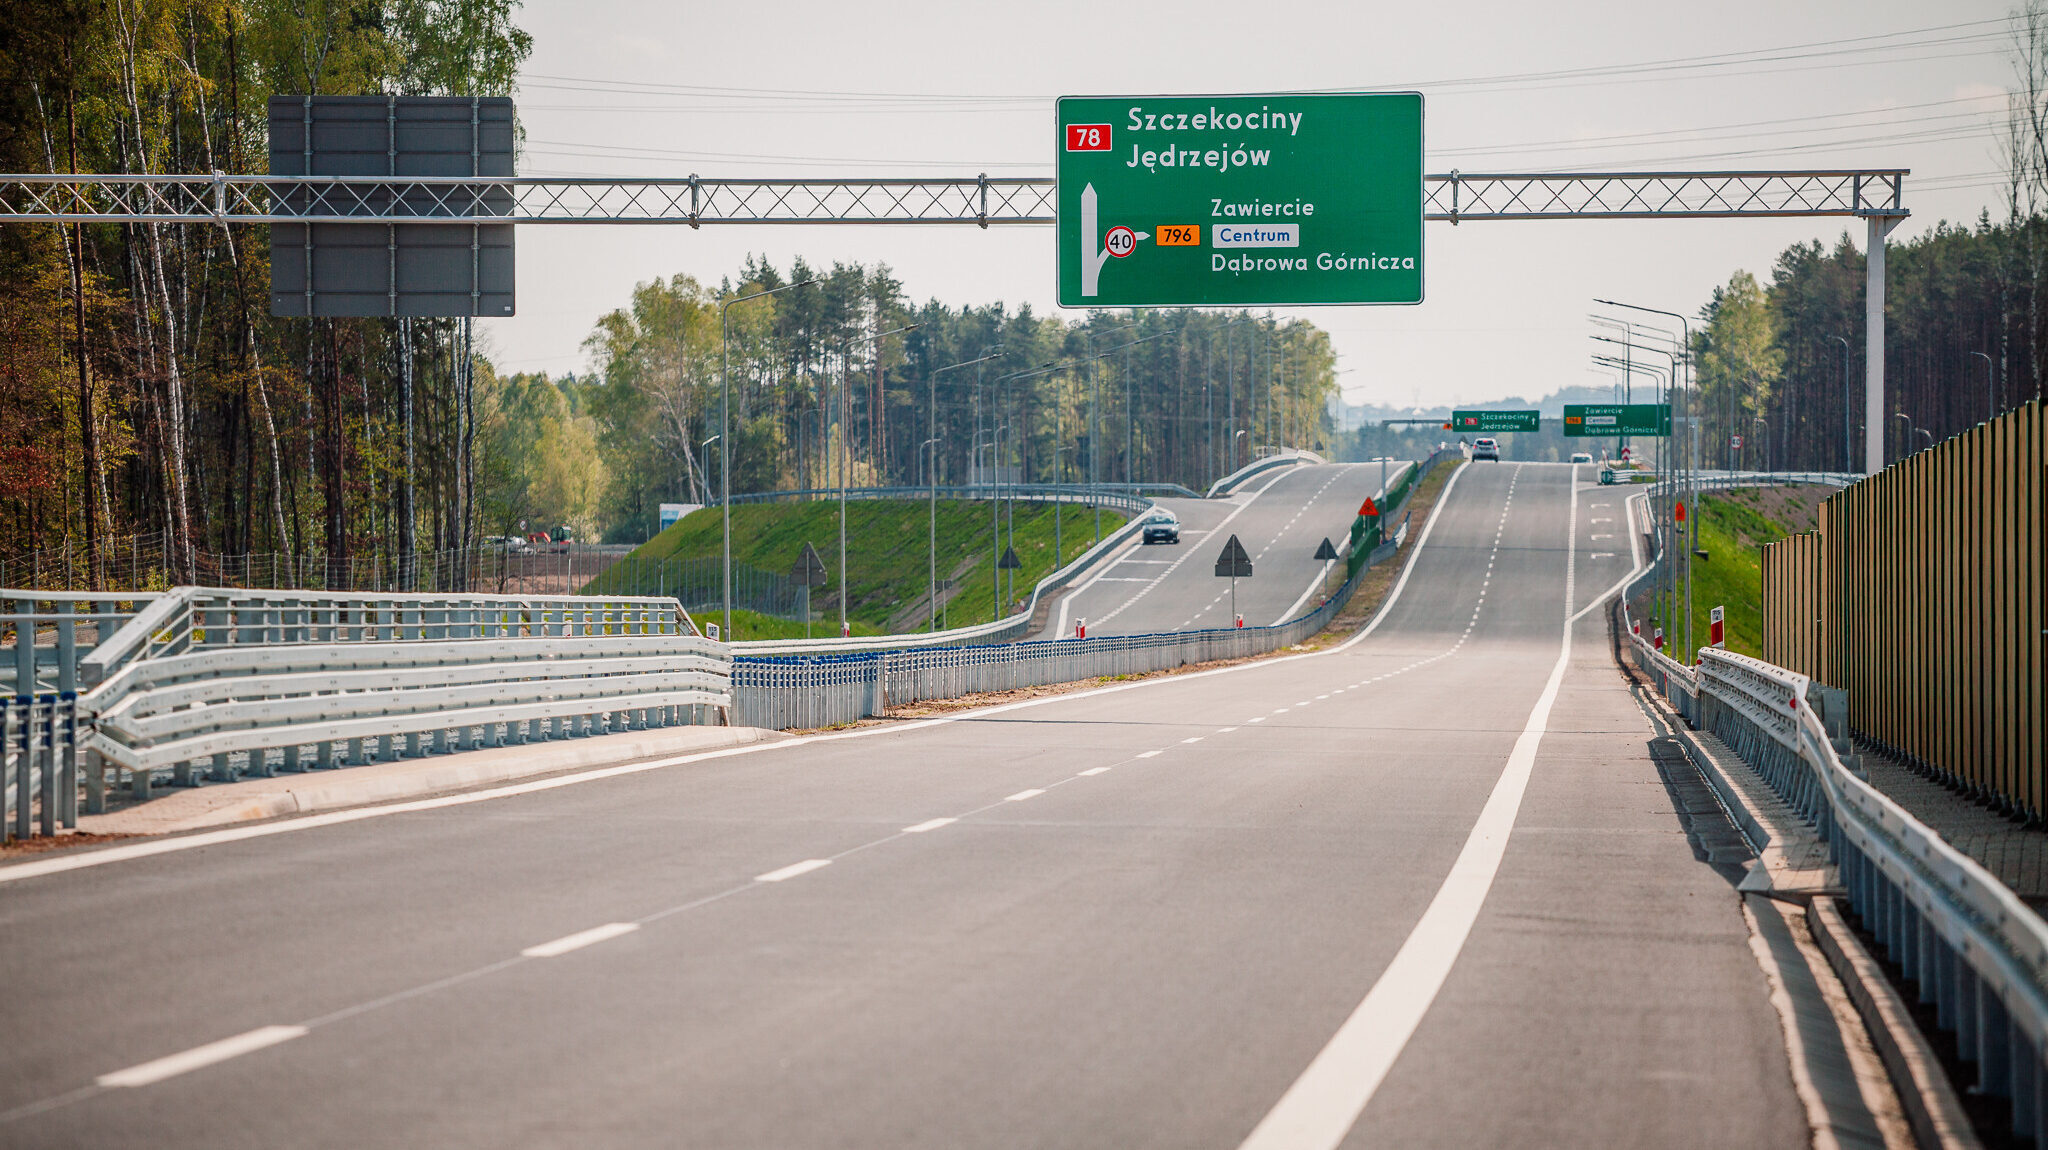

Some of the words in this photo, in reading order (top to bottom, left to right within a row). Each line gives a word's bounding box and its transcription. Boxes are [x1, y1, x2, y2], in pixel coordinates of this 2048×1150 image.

[1126, 106, 1303, 136] Szczekociny
[1076, 128, 1101, 147] 78
[1126, 143, 1271, 174] Jędrzejów
[1210, 198, 1315, 217] Zawiercie
[1109, 234, 1132, 249] 40
[1163, 228, 1192, 243] 796
[1219, 227, 1291, 242] Centrum
[1211, 253, 1308, 277] Dąbrowa
[1315, 252, 1415, 271] Górnicza
[1481, 413, 1529, 422] Szczekociny
[1584, 406, 1623, 414] Zawiercie
